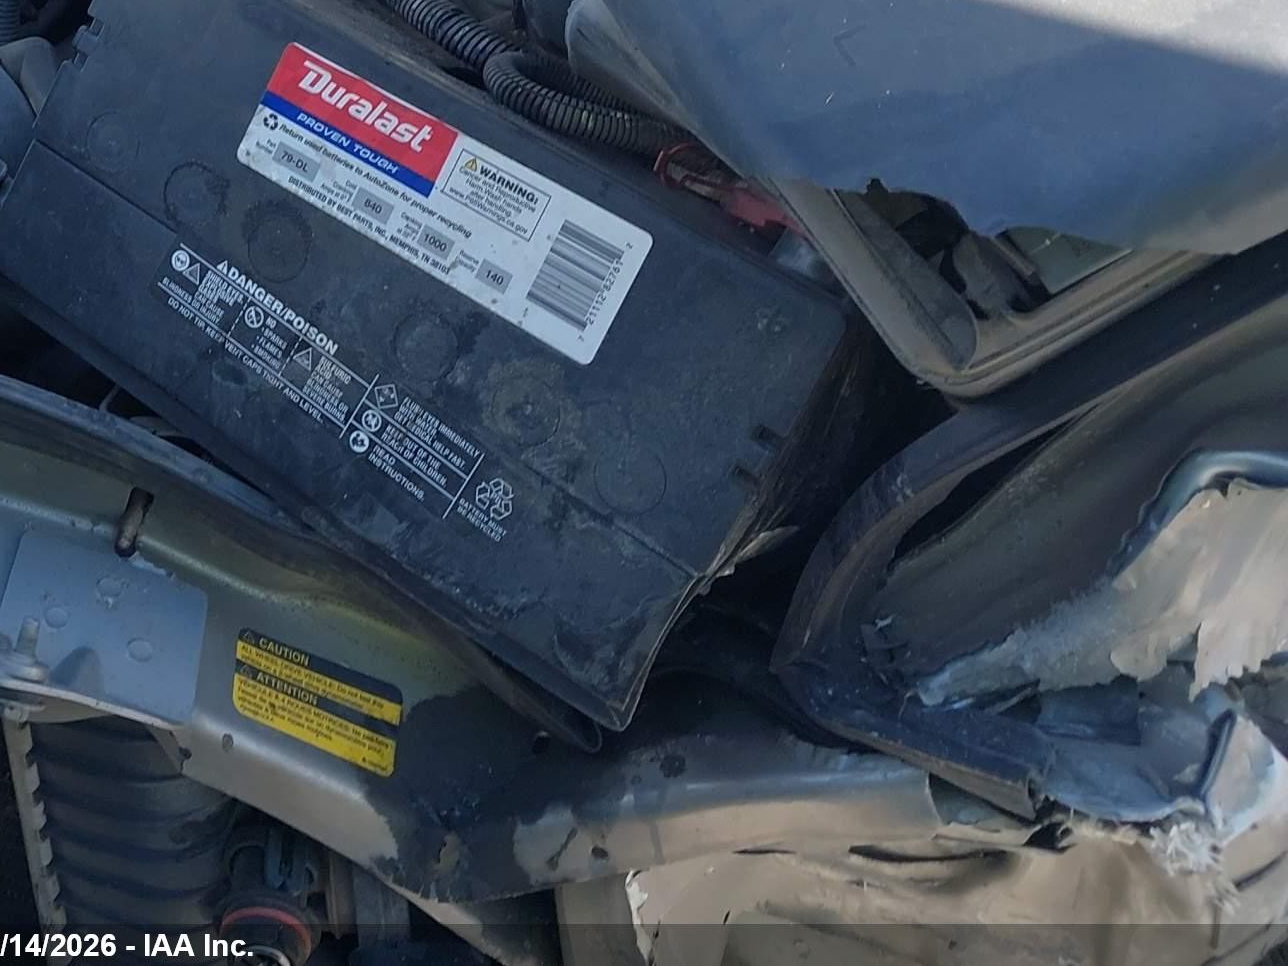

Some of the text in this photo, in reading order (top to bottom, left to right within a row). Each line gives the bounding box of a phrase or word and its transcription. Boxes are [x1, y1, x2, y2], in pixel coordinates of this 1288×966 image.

[296, 59, 435, 152] Duralast
[279, 150, 309, 173] 79-DL
[295, 111, 399, 175] PROVEN TOUGH
[278, 123, 473, 240] Return used batteries to AutoZone for proper recycling
[478, 165, 540, 205] WARNING:
[287, 174, 327, 203] DISTRIBUTED
[326, 197, 336, 208] BY
[336, 203, 352, 217] BEST
[351, 212, 375, 231] PARTS,
[388, 234, 421, 259] MEMPHIS,
[420, 252, 430, 263] TN
[422, 232, 448, 253] 1000
[485, 269, 504, 286] 140
[226, 265, 338, 355] DANGER/POISON
[264, 315, 277, 329] NO
[166, 296, 180, 310] DO
[177, 304, 194, 321] NOT
[204, 325, 225, 345] KEEP
[222, 339, 243, 359] VENT
[241, 354, 262, 374] CAPS
[261, 370, 283, 390] TIGHT
[282, 386, 300, 403] AND
[298, 399, 326, 423] LEVEL.
[310, 370, 324, 384] CAN
[318, 355, 351, 385] SULFURIC
[398, 403, 416, 421] WITH
[393, 410, 407, 425] GET
[431, 439, 450, 457] HELP
[421, 410, 440, 428] EYES
[437, 422, 480, 459] IMMEDIATELY
[372, 444, 396, 466] READ
[380, 430, 449, 488] REACH OF CHILDREN.
[402, 436, 418, 452] OUT
[416, 447, 427, 459] OF
[425, 454, 441, 470] THE
[367, 452, 427, 501] INSTRUCTIONS.
[456, 505, 501, 542] BE RECYCLED
[458, 497, 507, 536] BATTERY MUST
[259, 637, 311, 667] CAUTION
[256, 672, 319, 707] ATTENTION
